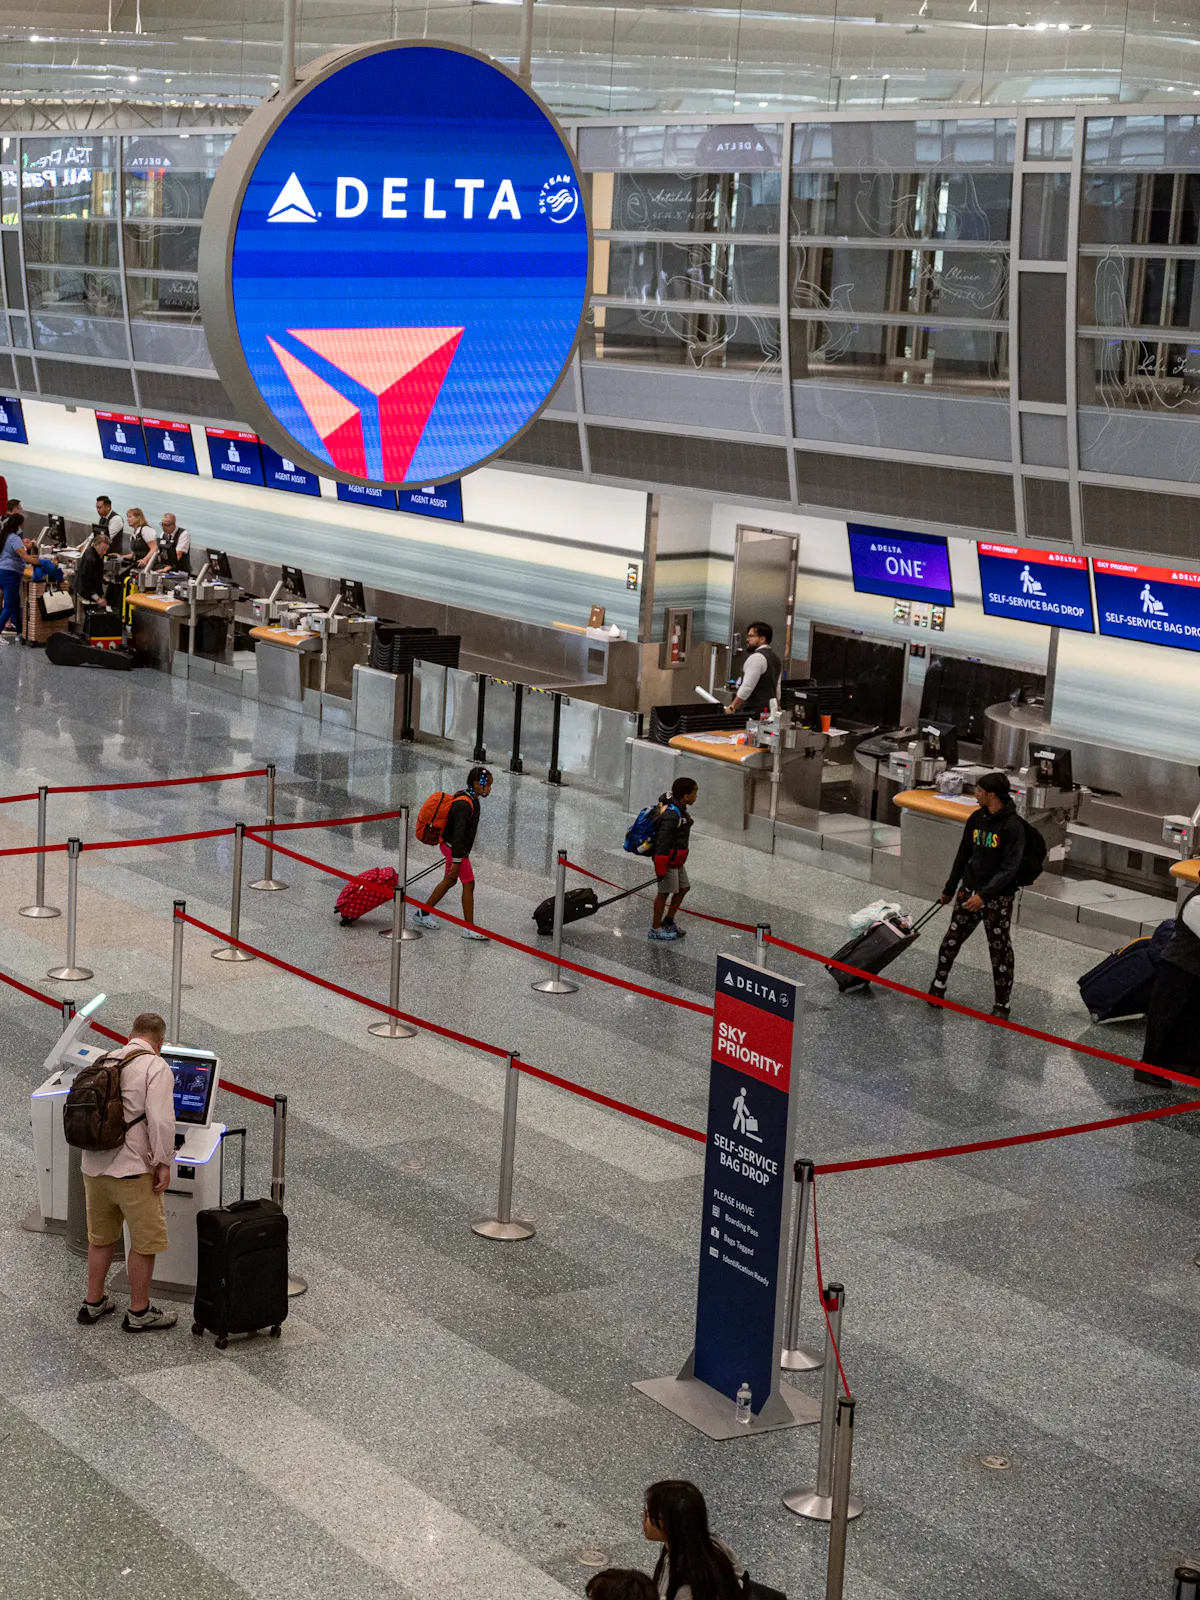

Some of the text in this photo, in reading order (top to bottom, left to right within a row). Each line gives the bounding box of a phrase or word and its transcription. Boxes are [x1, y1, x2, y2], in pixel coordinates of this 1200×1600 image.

[335, 176, 522, 220] DELTA
[539, 174, 571, 214] SKYTEAM
[220, 463, 251, 475] AGENT ASSIST
[275, 472, 307, 484] AGENT ASSIST
[348, 484, 383, 497] AGENT ASSIST
[410, 494, 448, 508] AGENT ASSIST
[877, 544, 902, 554] DELTA
[992, 545, 1018, 555] PRIORITY
[1055, 554, 1077, 564] DELTA
[886, 556, 924, 579] ONE
[1110, 564, 1138, 573] PRIORITY
[988, 592, 1085, 617] SELF-SERVICE BAG DROP
[1105, 612, 1163, 631] SELF-SERVICE
[1163, 622, 1183, 634] BAG
[736, 975, 777, 1003] DELTA
[718, 1022, 747, 1045] SKY
[718, 1036, 782, 1076] PRIORITY
[713, 1133, 778, 1176] SELF-SERVICE
[720, 1152, 770, 1186] BAG DROP
[713, 1188, 755, 1217] PLEASE HAVE:
[725, 1213, 759, 1238] Boarding Pass
[723, 1233, 754, 1256] Bags Tagged
[722, 1253, 770, 1287] Identification Ready
